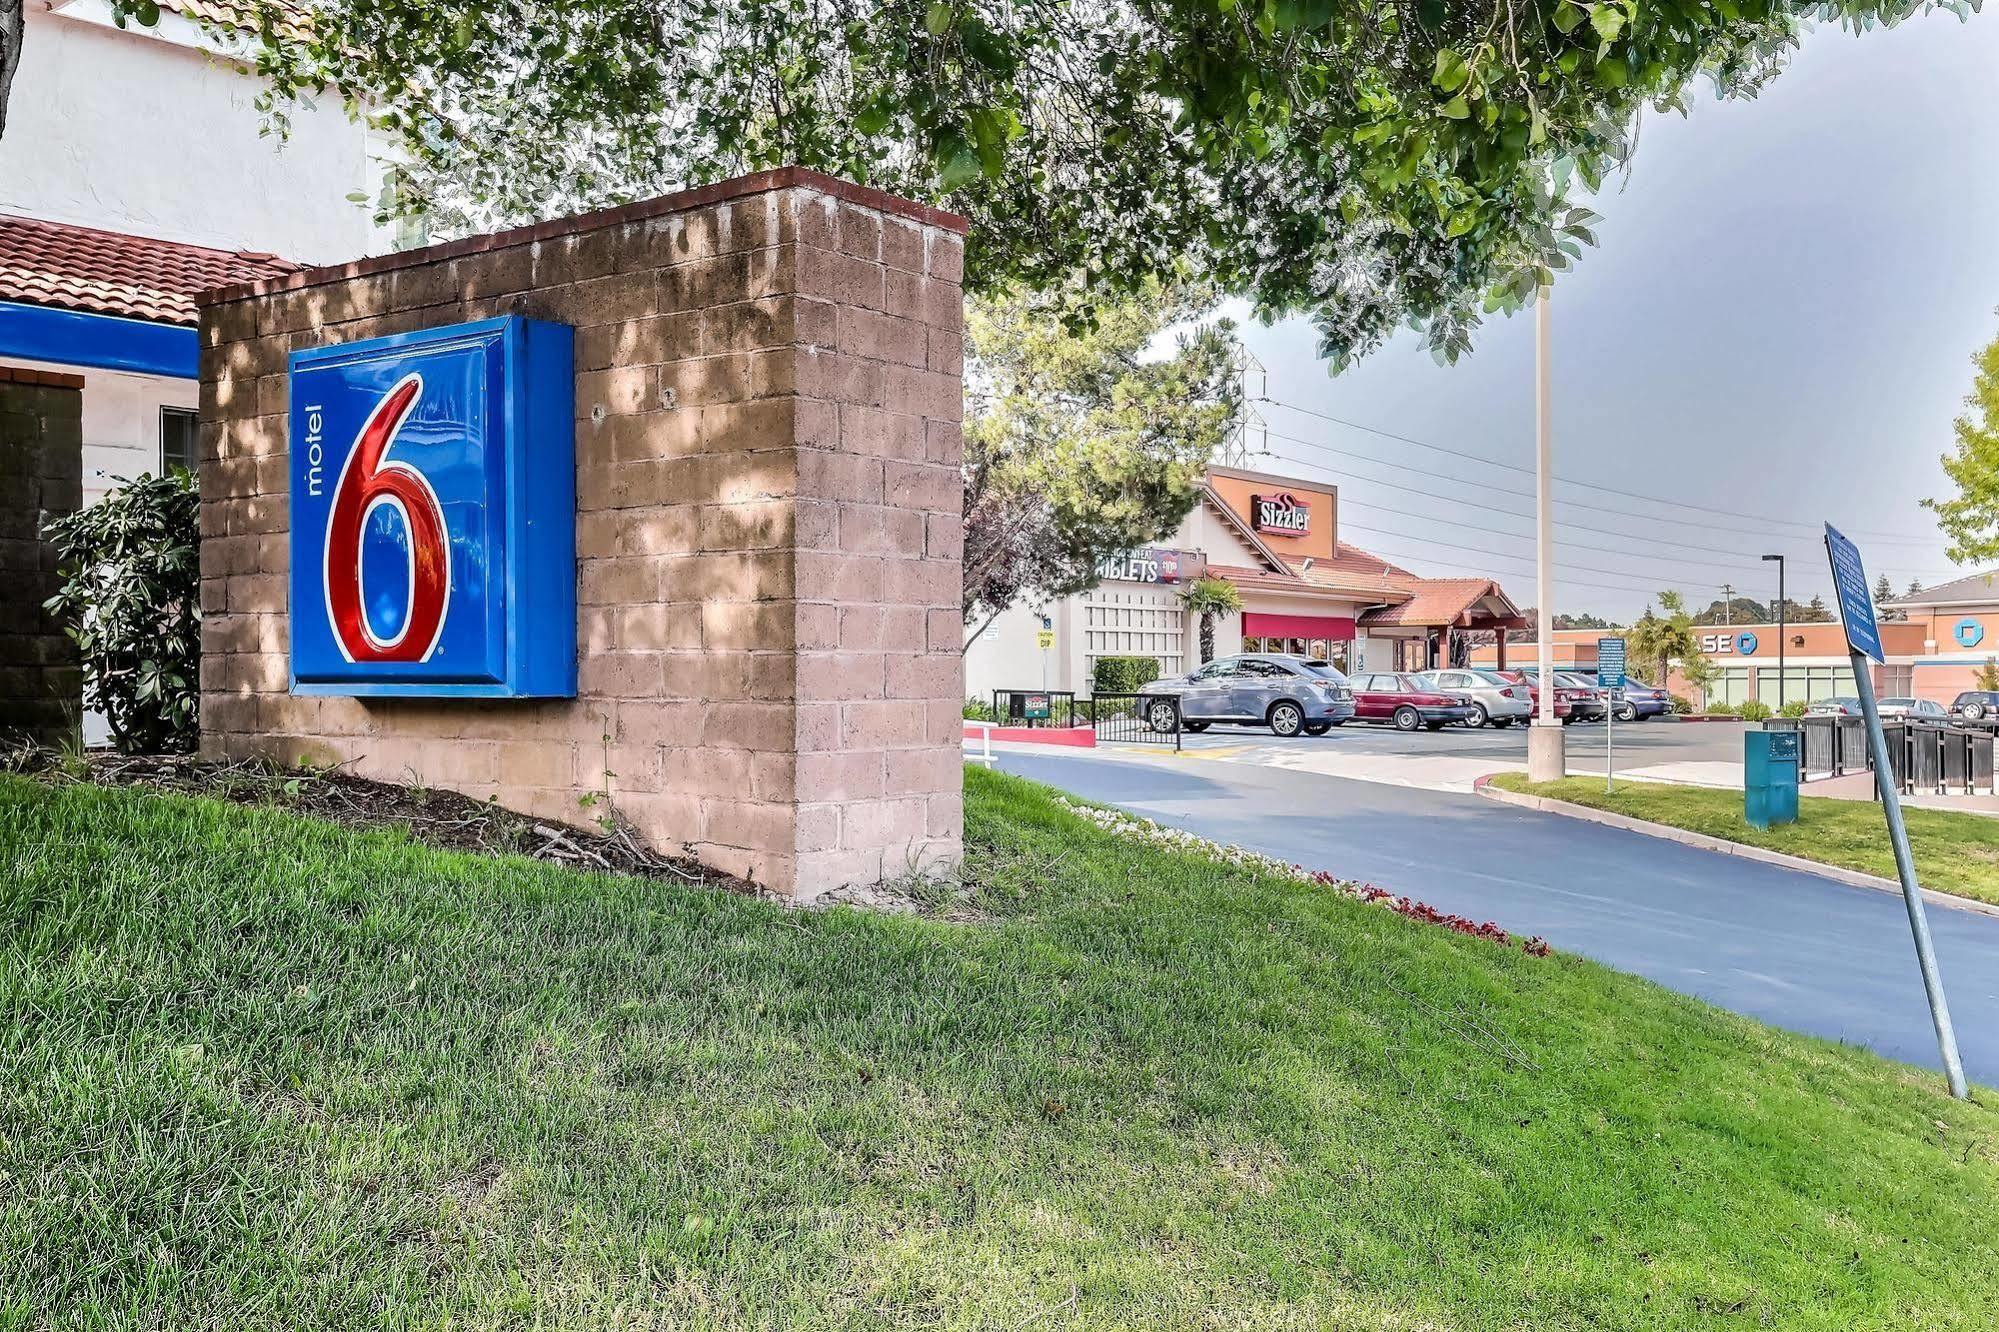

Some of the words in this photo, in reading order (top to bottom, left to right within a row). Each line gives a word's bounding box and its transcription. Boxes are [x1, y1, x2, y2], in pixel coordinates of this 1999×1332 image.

[304, 404, 323, 497] motel
[323, 372, 451, 664] 6
[1260, 501, 1311, 531] Sizzler
